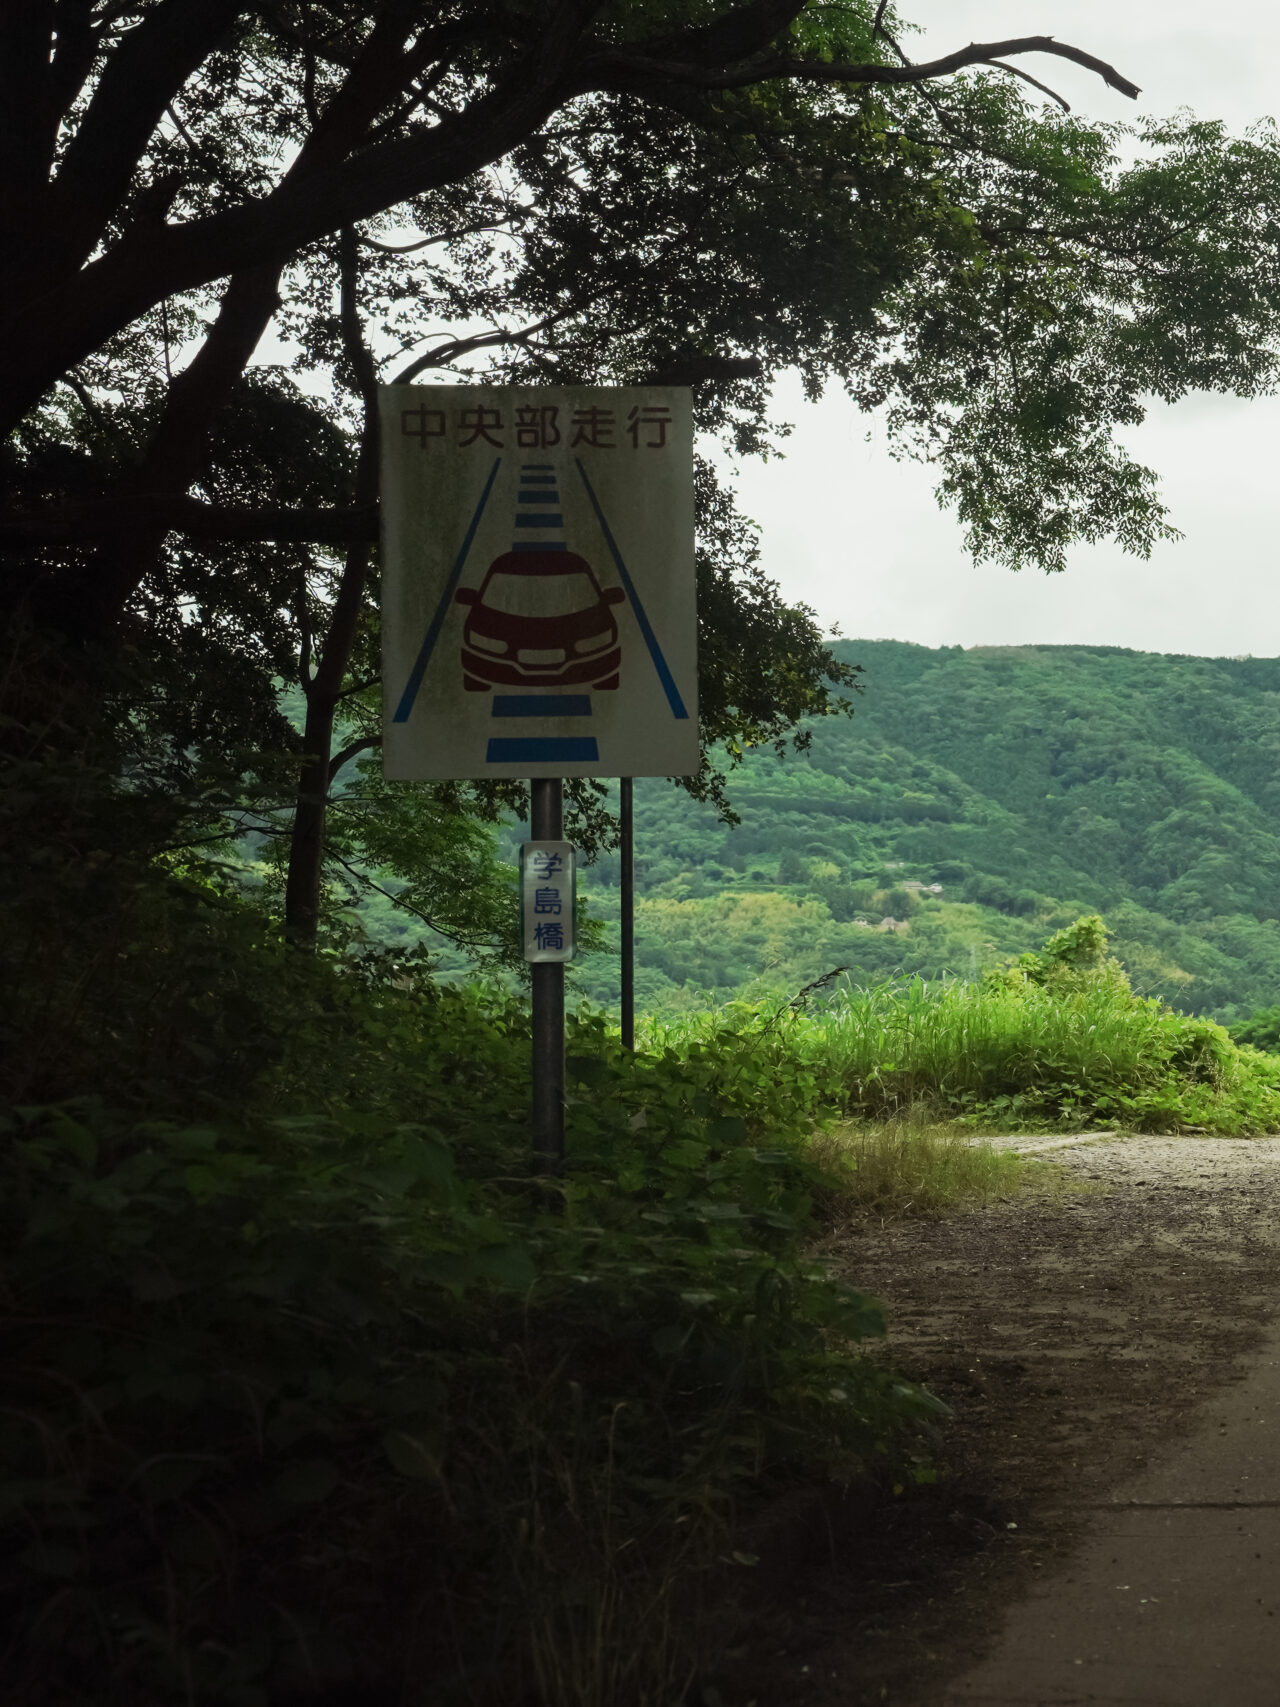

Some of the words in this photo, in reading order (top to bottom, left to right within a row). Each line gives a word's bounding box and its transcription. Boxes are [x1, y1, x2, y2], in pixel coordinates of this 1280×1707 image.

[401, 403, 672, 449] 中央部走行
[533, 852, 564, 950] 学島橋
